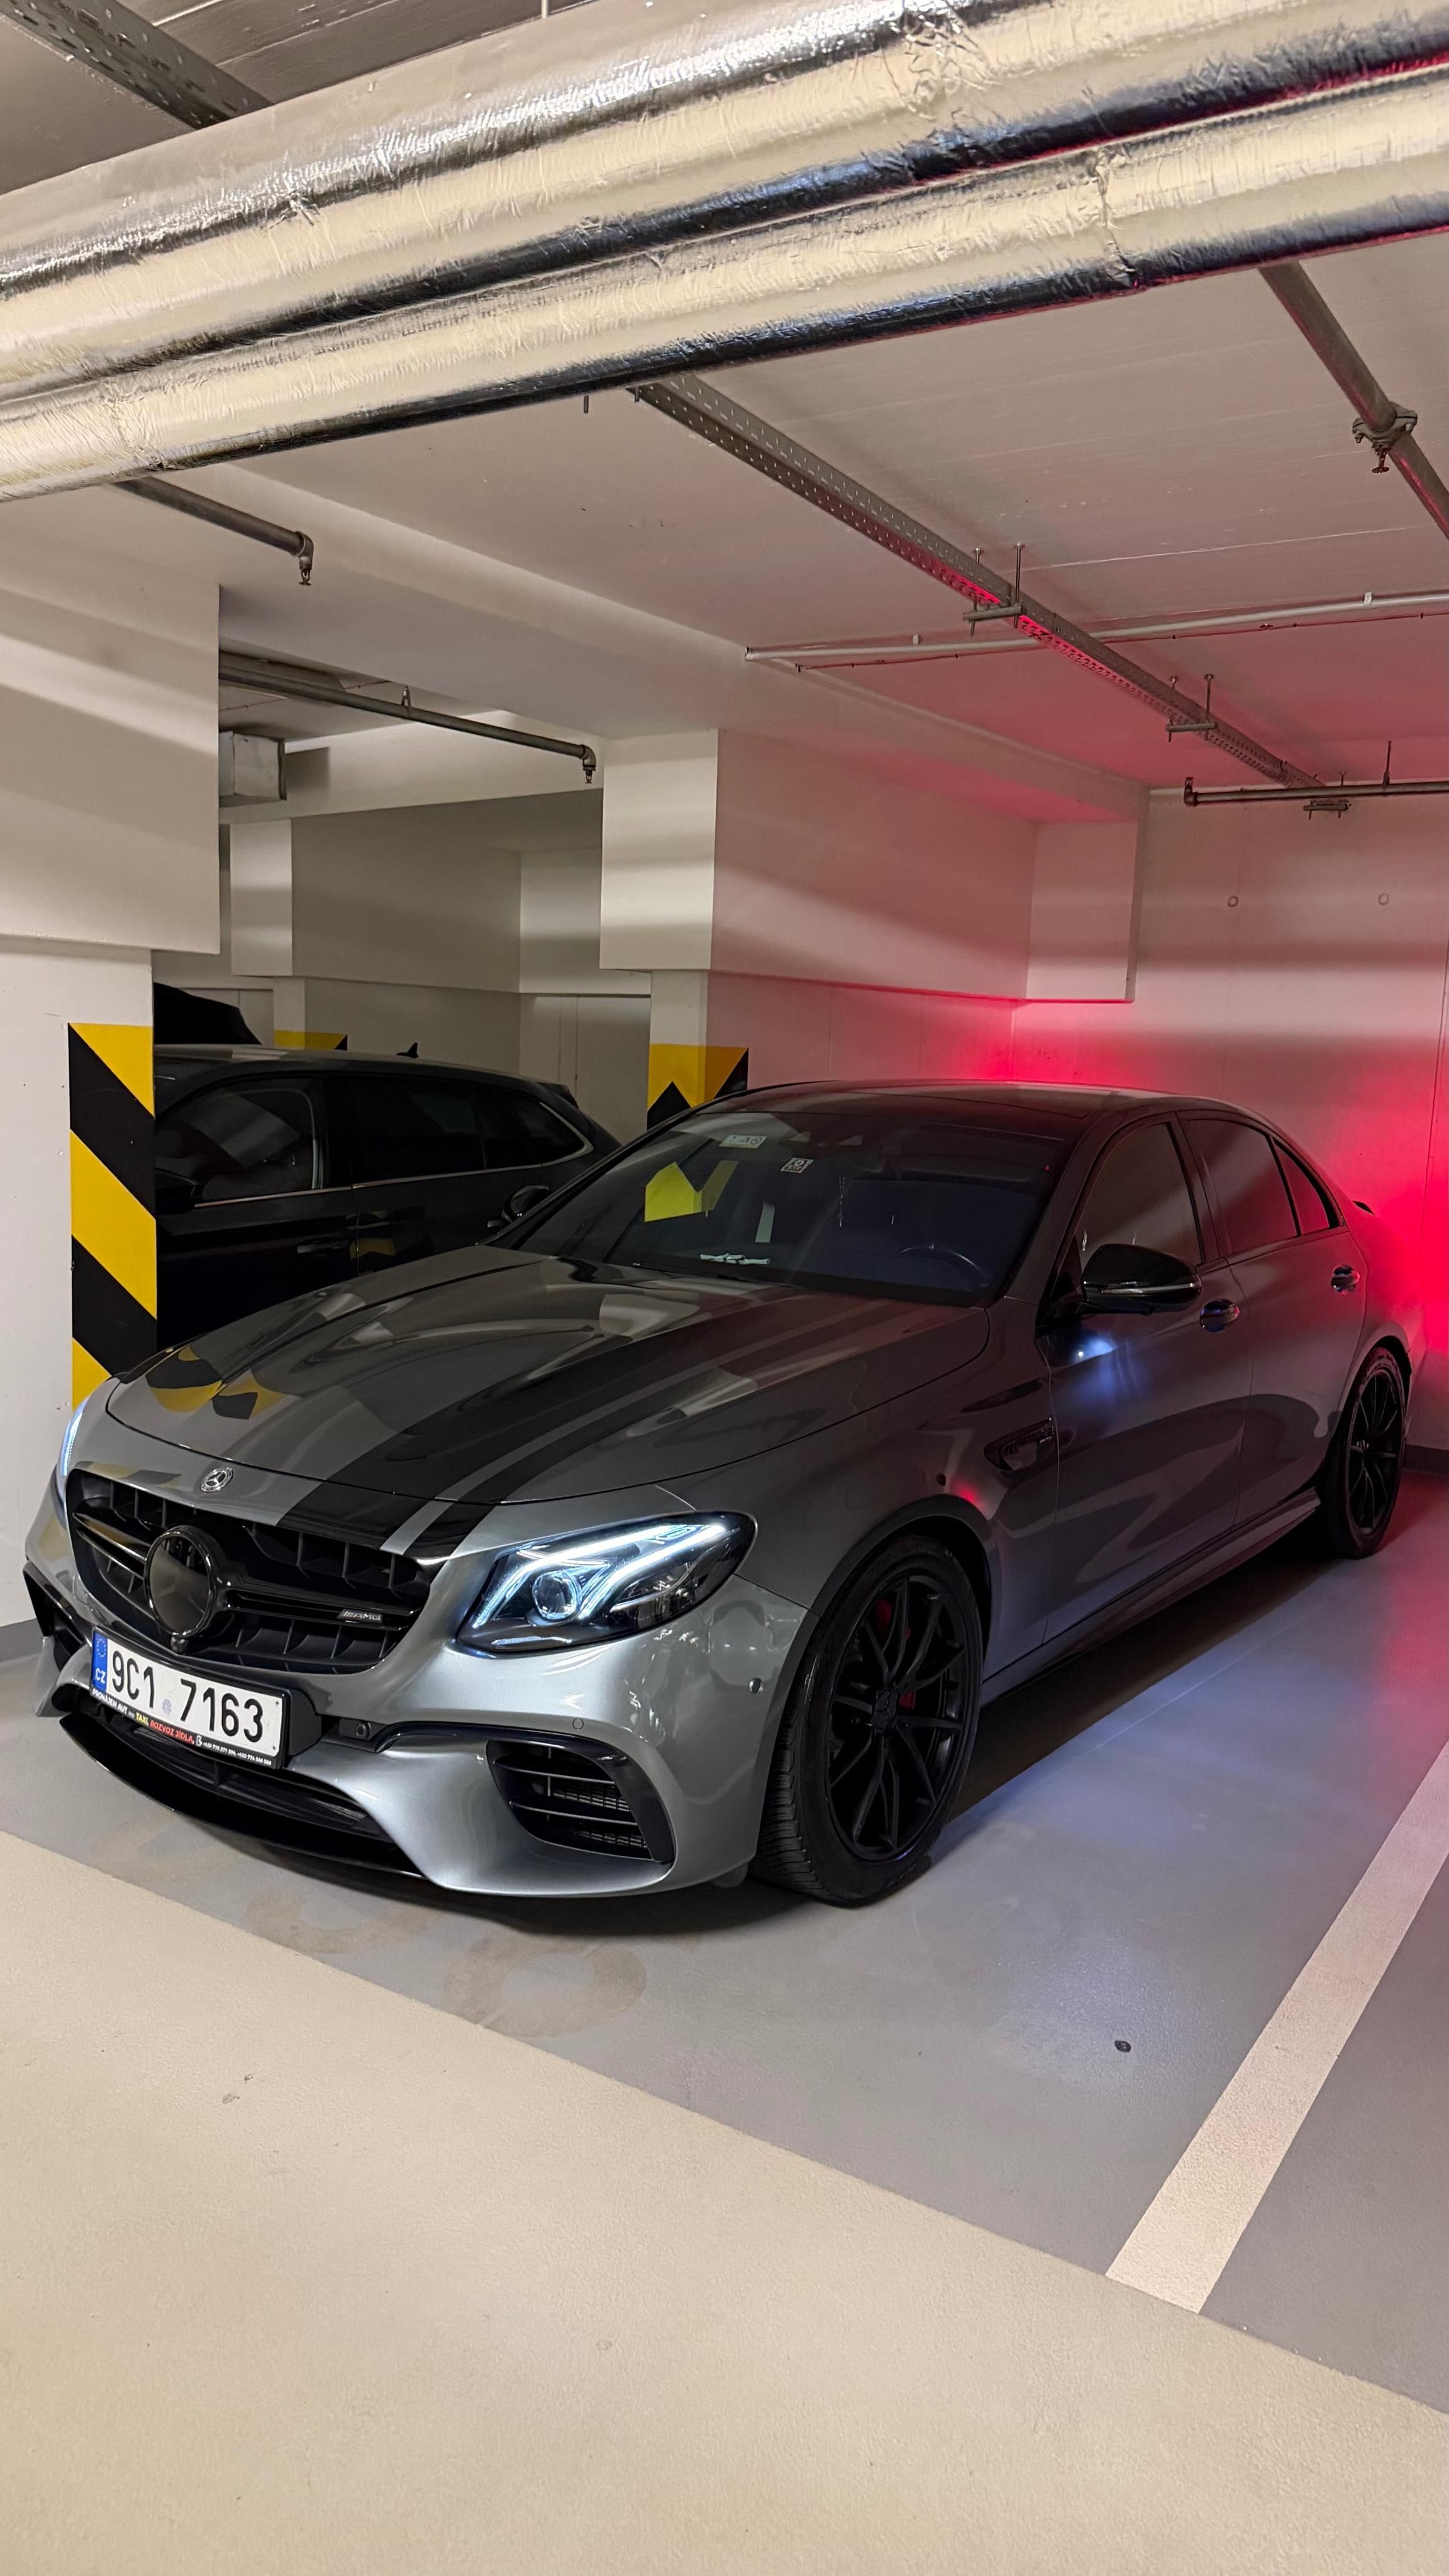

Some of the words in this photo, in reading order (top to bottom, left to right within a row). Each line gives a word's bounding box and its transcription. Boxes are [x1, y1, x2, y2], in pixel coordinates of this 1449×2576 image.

[96, 1668, 106, 1684] CZ
[112, 1650, 155, 1708] 9C1
[180, 1679, 264, 1743] 7163
[118, 1703, 128, 1714] AUT
[150, 1720, 175, 1736] ROZVOZ
